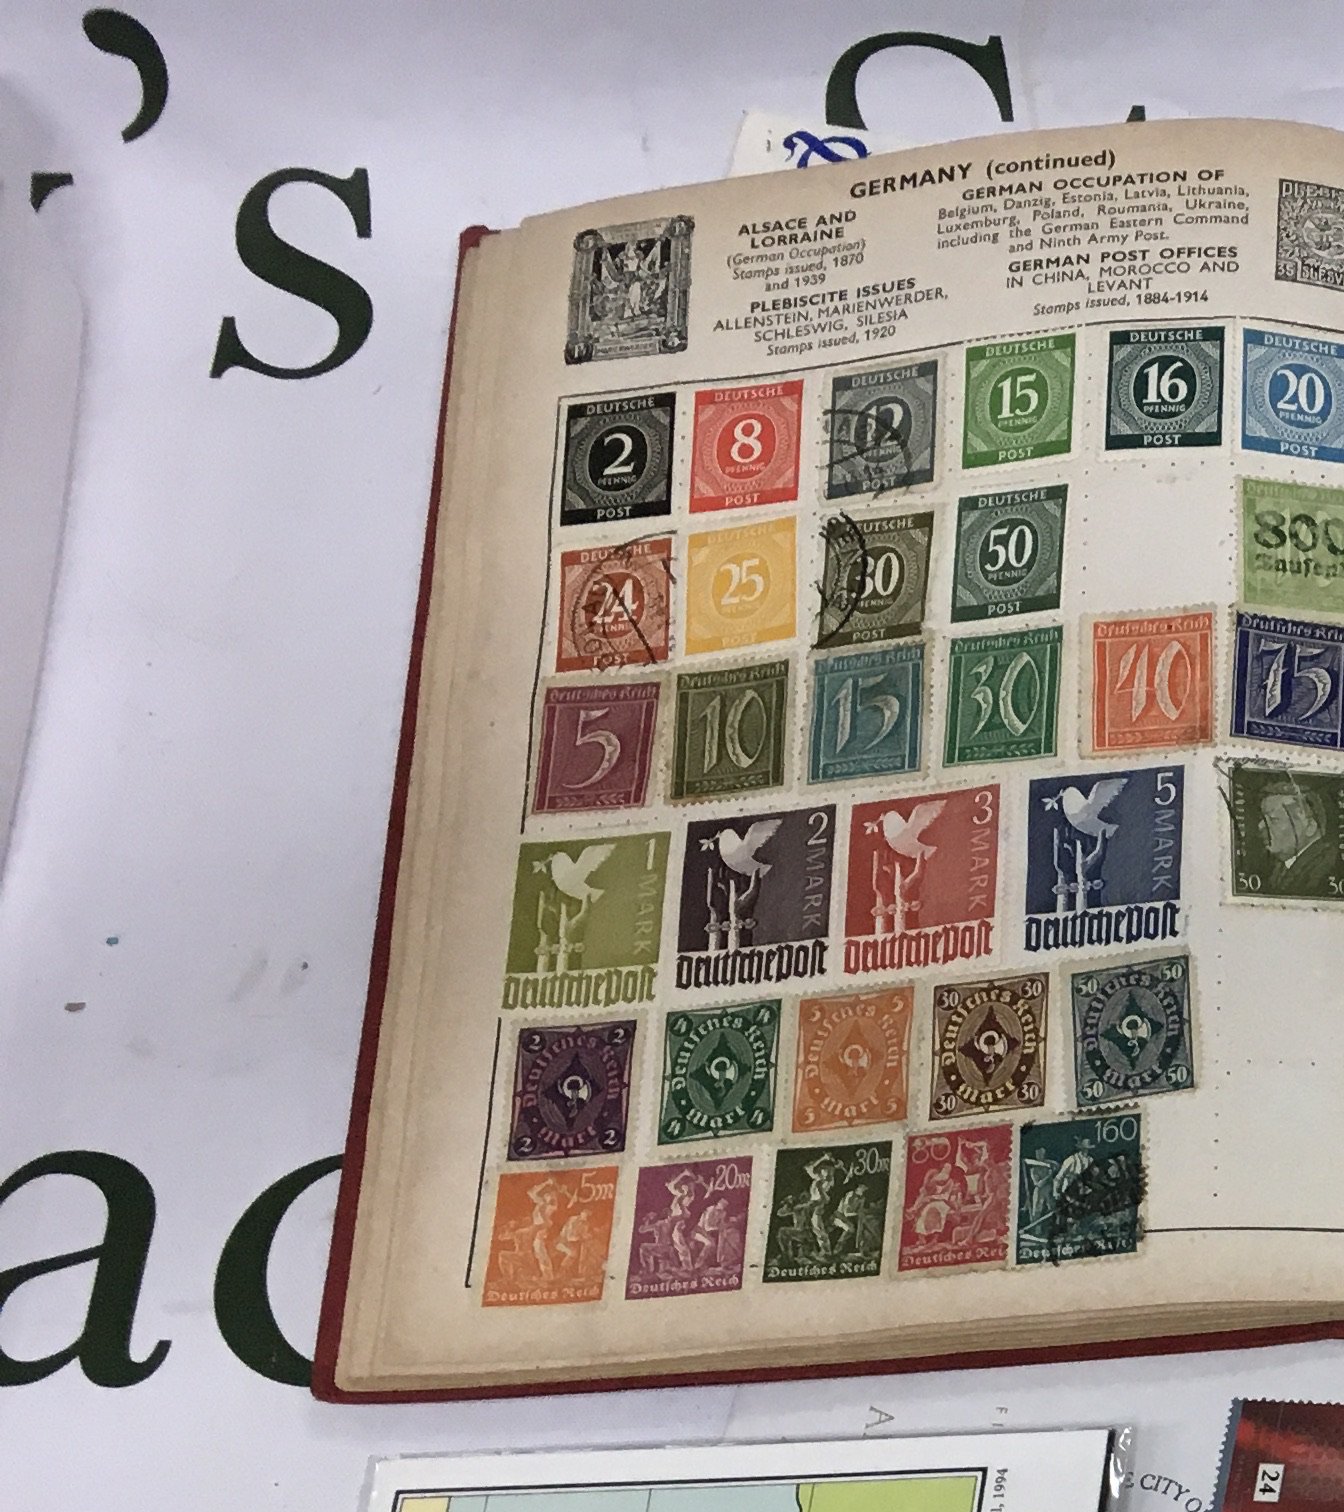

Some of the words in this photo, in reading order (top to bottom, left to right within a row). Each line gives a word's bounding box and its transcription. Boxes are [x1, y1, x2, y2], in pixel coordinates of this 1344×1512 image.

[850, 162, 972, 199] GERMANY
[986, 149, 1116, 181] (continued)
[962, 180, 1043, 201] GERMAN
[1054, 170, 1188, 191] OCCUPATION
[1198, 169, 1225, 181] OF
[937, 202, 998, 221] Belgium,
[1004, 196, 1056, 212] Danzig,
[1062, 190, 1118, 205] Estonia,
[1124, 187, 1171, 200] Latvia,
[1177, 184, 1250, 197] Lithuania,
[937, 214, 1020, 235] Luxemburg,
[1032, 206, 1084, 221] Poland,
[1097, 201, 1173, 216] Roumania,
[1185, 198, 1250, 212] Ukraine,
[738, 217, 808, 236] ALSACE
[815, 209, 857, 226] AND
[937, 230, 1000, 250] including
[1009, 225, 1032, 239] the
[1041, 221, 1099, 235] German
[1110, 216, 1163, 228] Eastern
[1173, 214, 1249, 226] Command
[750, 227, 844, 249] LORRAINE
[1008, 240, 1033, 253] and
[1040, 235, 1081, 249] Ninth
[1087, 232, 1129, 246] Army
[1135, 228, 1169, 241] Post.
[726, 250, 784, 268] (German
[789, 238, 866, 260] Occupation)
[732, 264, 780, 281] Stamps
[786, 260, 827, 275] issued,
[832, 252, 864, 268] 1870
[1008, 254, 1090, 273] GERMAN
[1100, 250, 1150, 263] POST
[1160, 246, 1238, 259] OFFICES
[765, 279, 789, 292] and
[795, 273, 827, 288] 1939
[1006, 276, 1024, 289] IN
[1032, 270, 1090, 286] CHINA,
[1099, 262, 1191, 277] MOROCCO
[1199, 261, 1240, 273] AND
[1088, 278, 1153, 294] LEVANT
[713, 311, 813, 332] ALLENSTEIN,
[818, 287, 948, 319] MARIENWERDER,
[750, 290, 848, 313] PLEBISCITE
[857, 278, 916, 298] ISSUES
[1033, 301, 1081, 316] Stamps
[1085, 295, 1131, 309] issued,
[1136, 290, 1209, 305] 1884-1914
[754, 318, 848, 343] SCHLESWIG,
[856, 310, 909, 327] SILESIA
[1129, 328, 1203, 343] DEUTSCHE
[767, 340, 813, 357] Stamps
[818, 333, 860, 349] issued,
[864, 325, 896, 340] 1920
[1142, 361, 1188, 405] 16
[586, 397, 655, 414] DEUTSCHE
[603, 432, 635, 476] 2
[1143, 434, 1182, 446] POST
[597, 506, 632, 519] POST
[1259, 1470, 1280, 1495] 24
